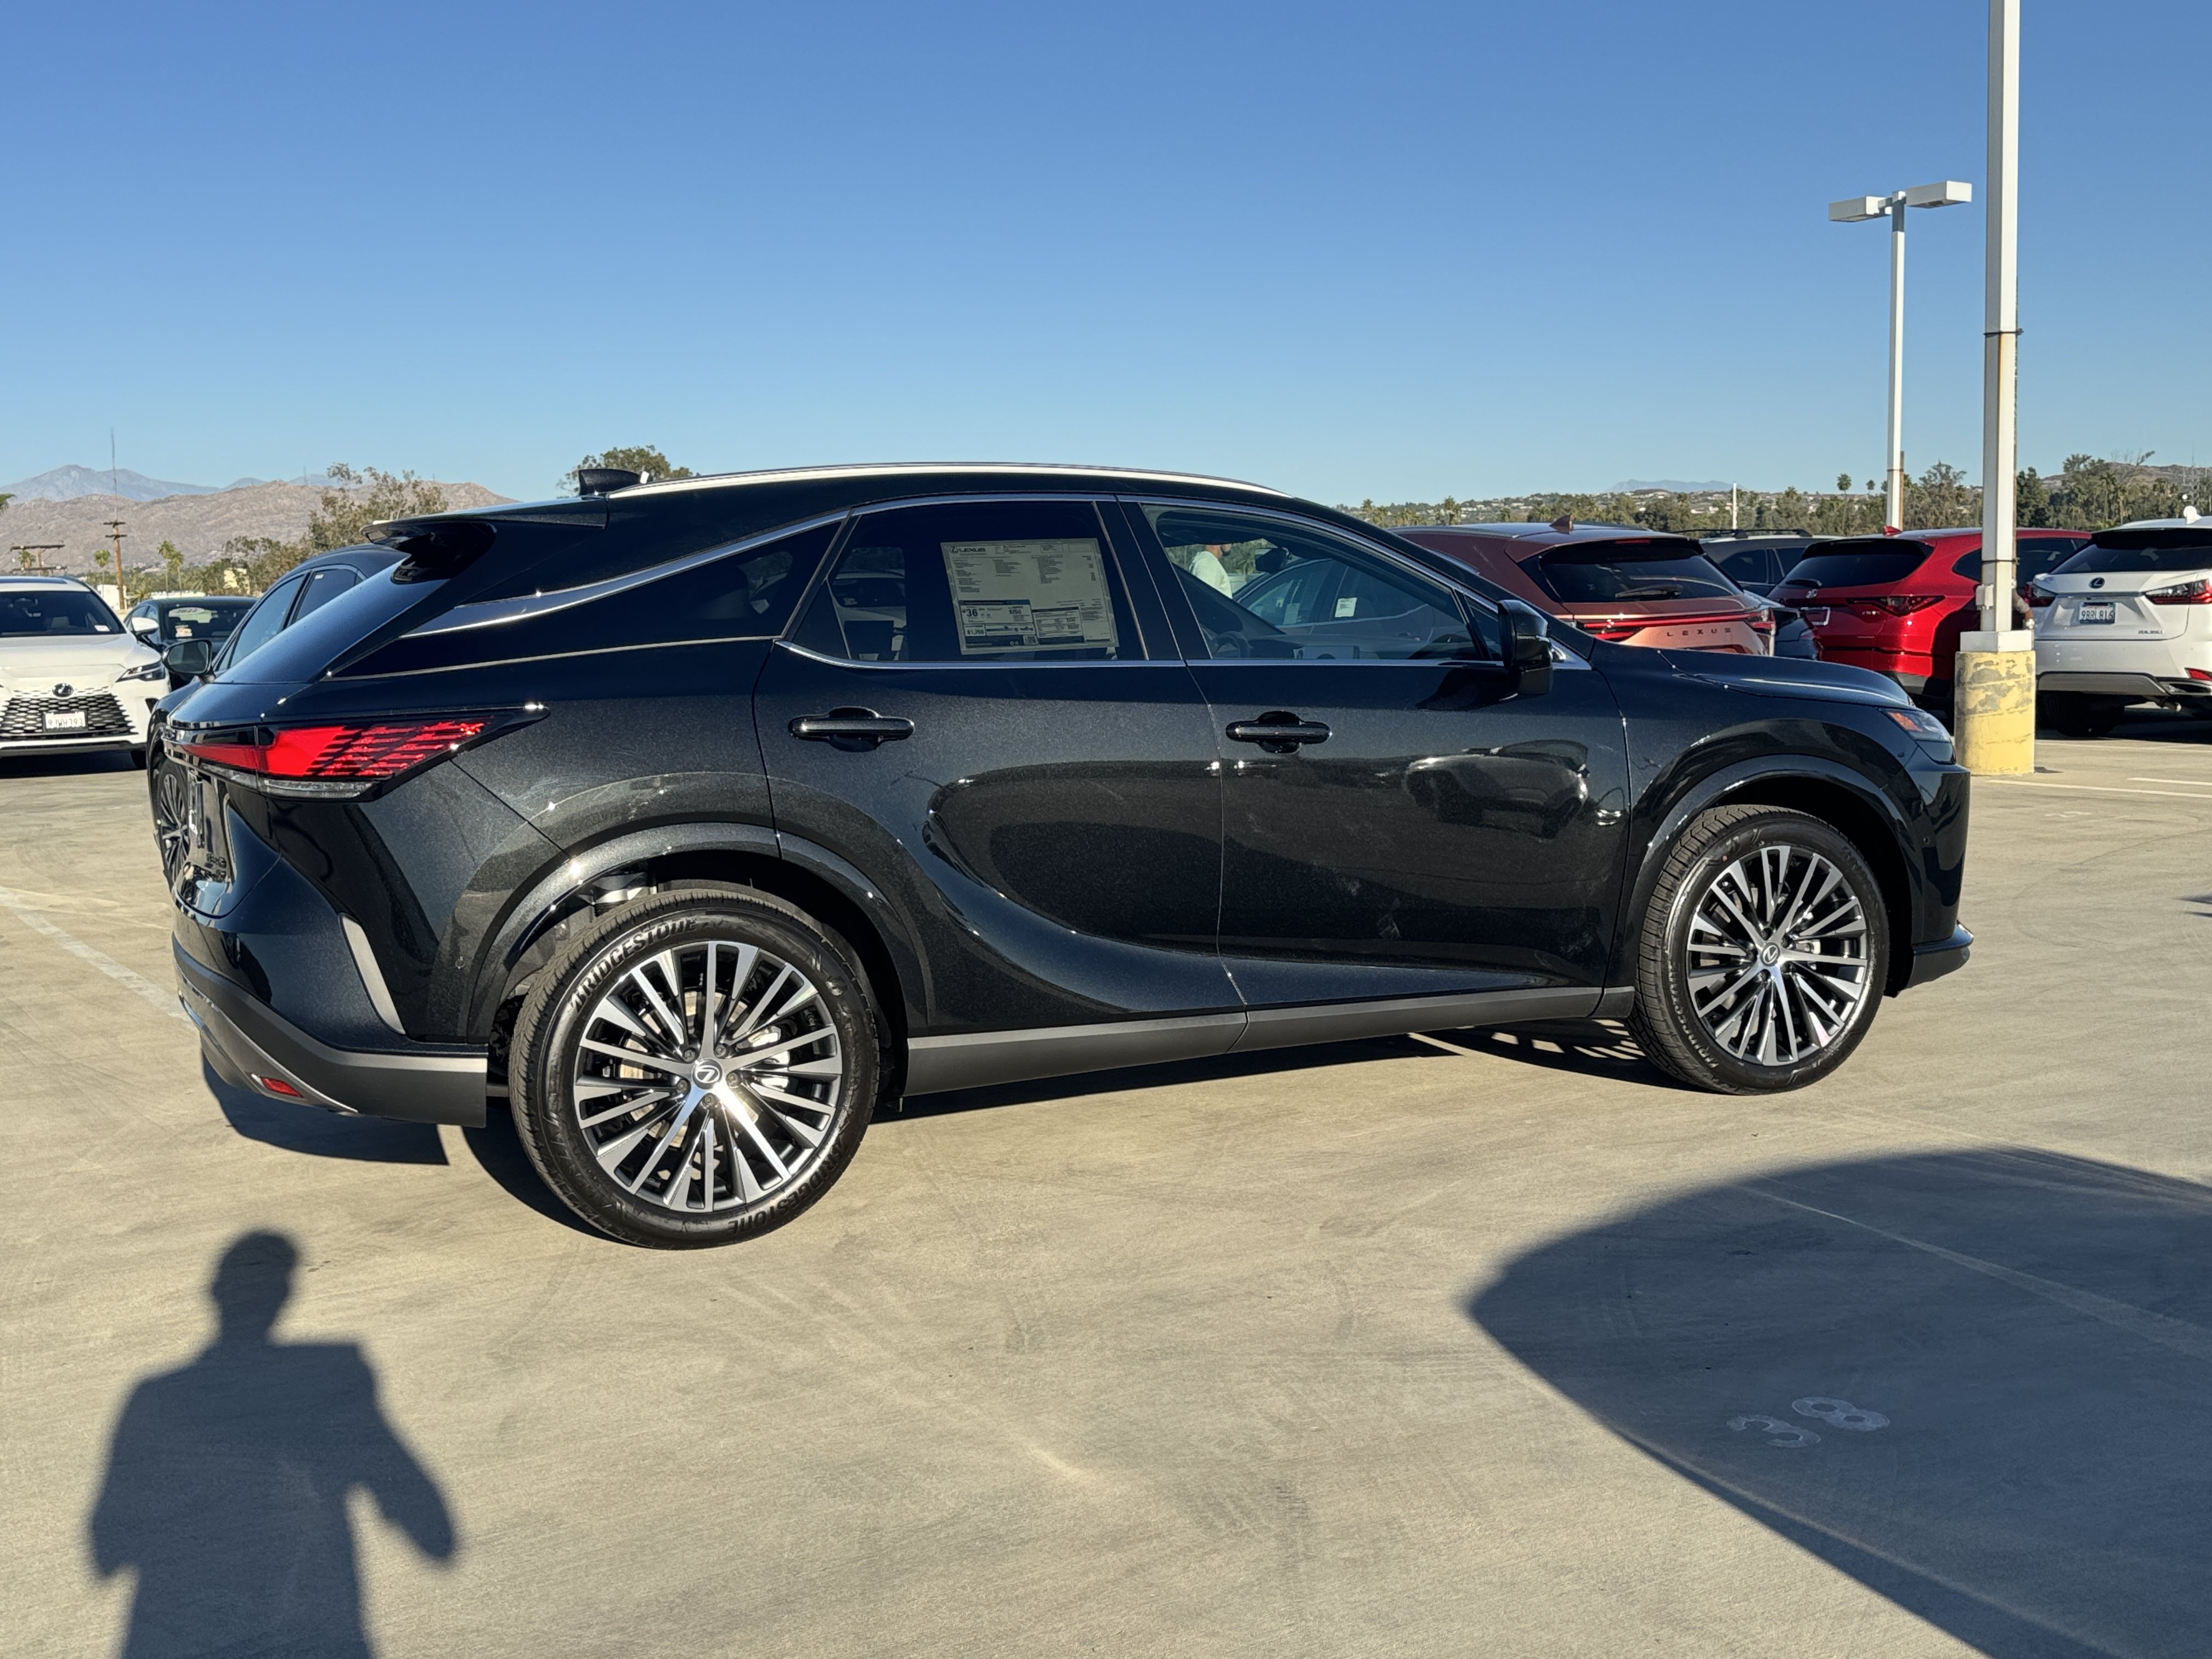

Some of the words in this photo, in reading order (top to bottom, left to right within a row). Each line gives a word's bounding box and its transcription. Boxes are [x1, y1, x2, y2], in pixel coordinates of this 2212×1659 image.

[967, 608, 978, 617] 36
[1667, 628, 1731, 636] LEXUS
[570, 918, 697, 1014] BRIDGESTONE
[728, 1138, 849, 1234] BRIDGESTONE
[1726, 1396, 1891, 1448] 38
